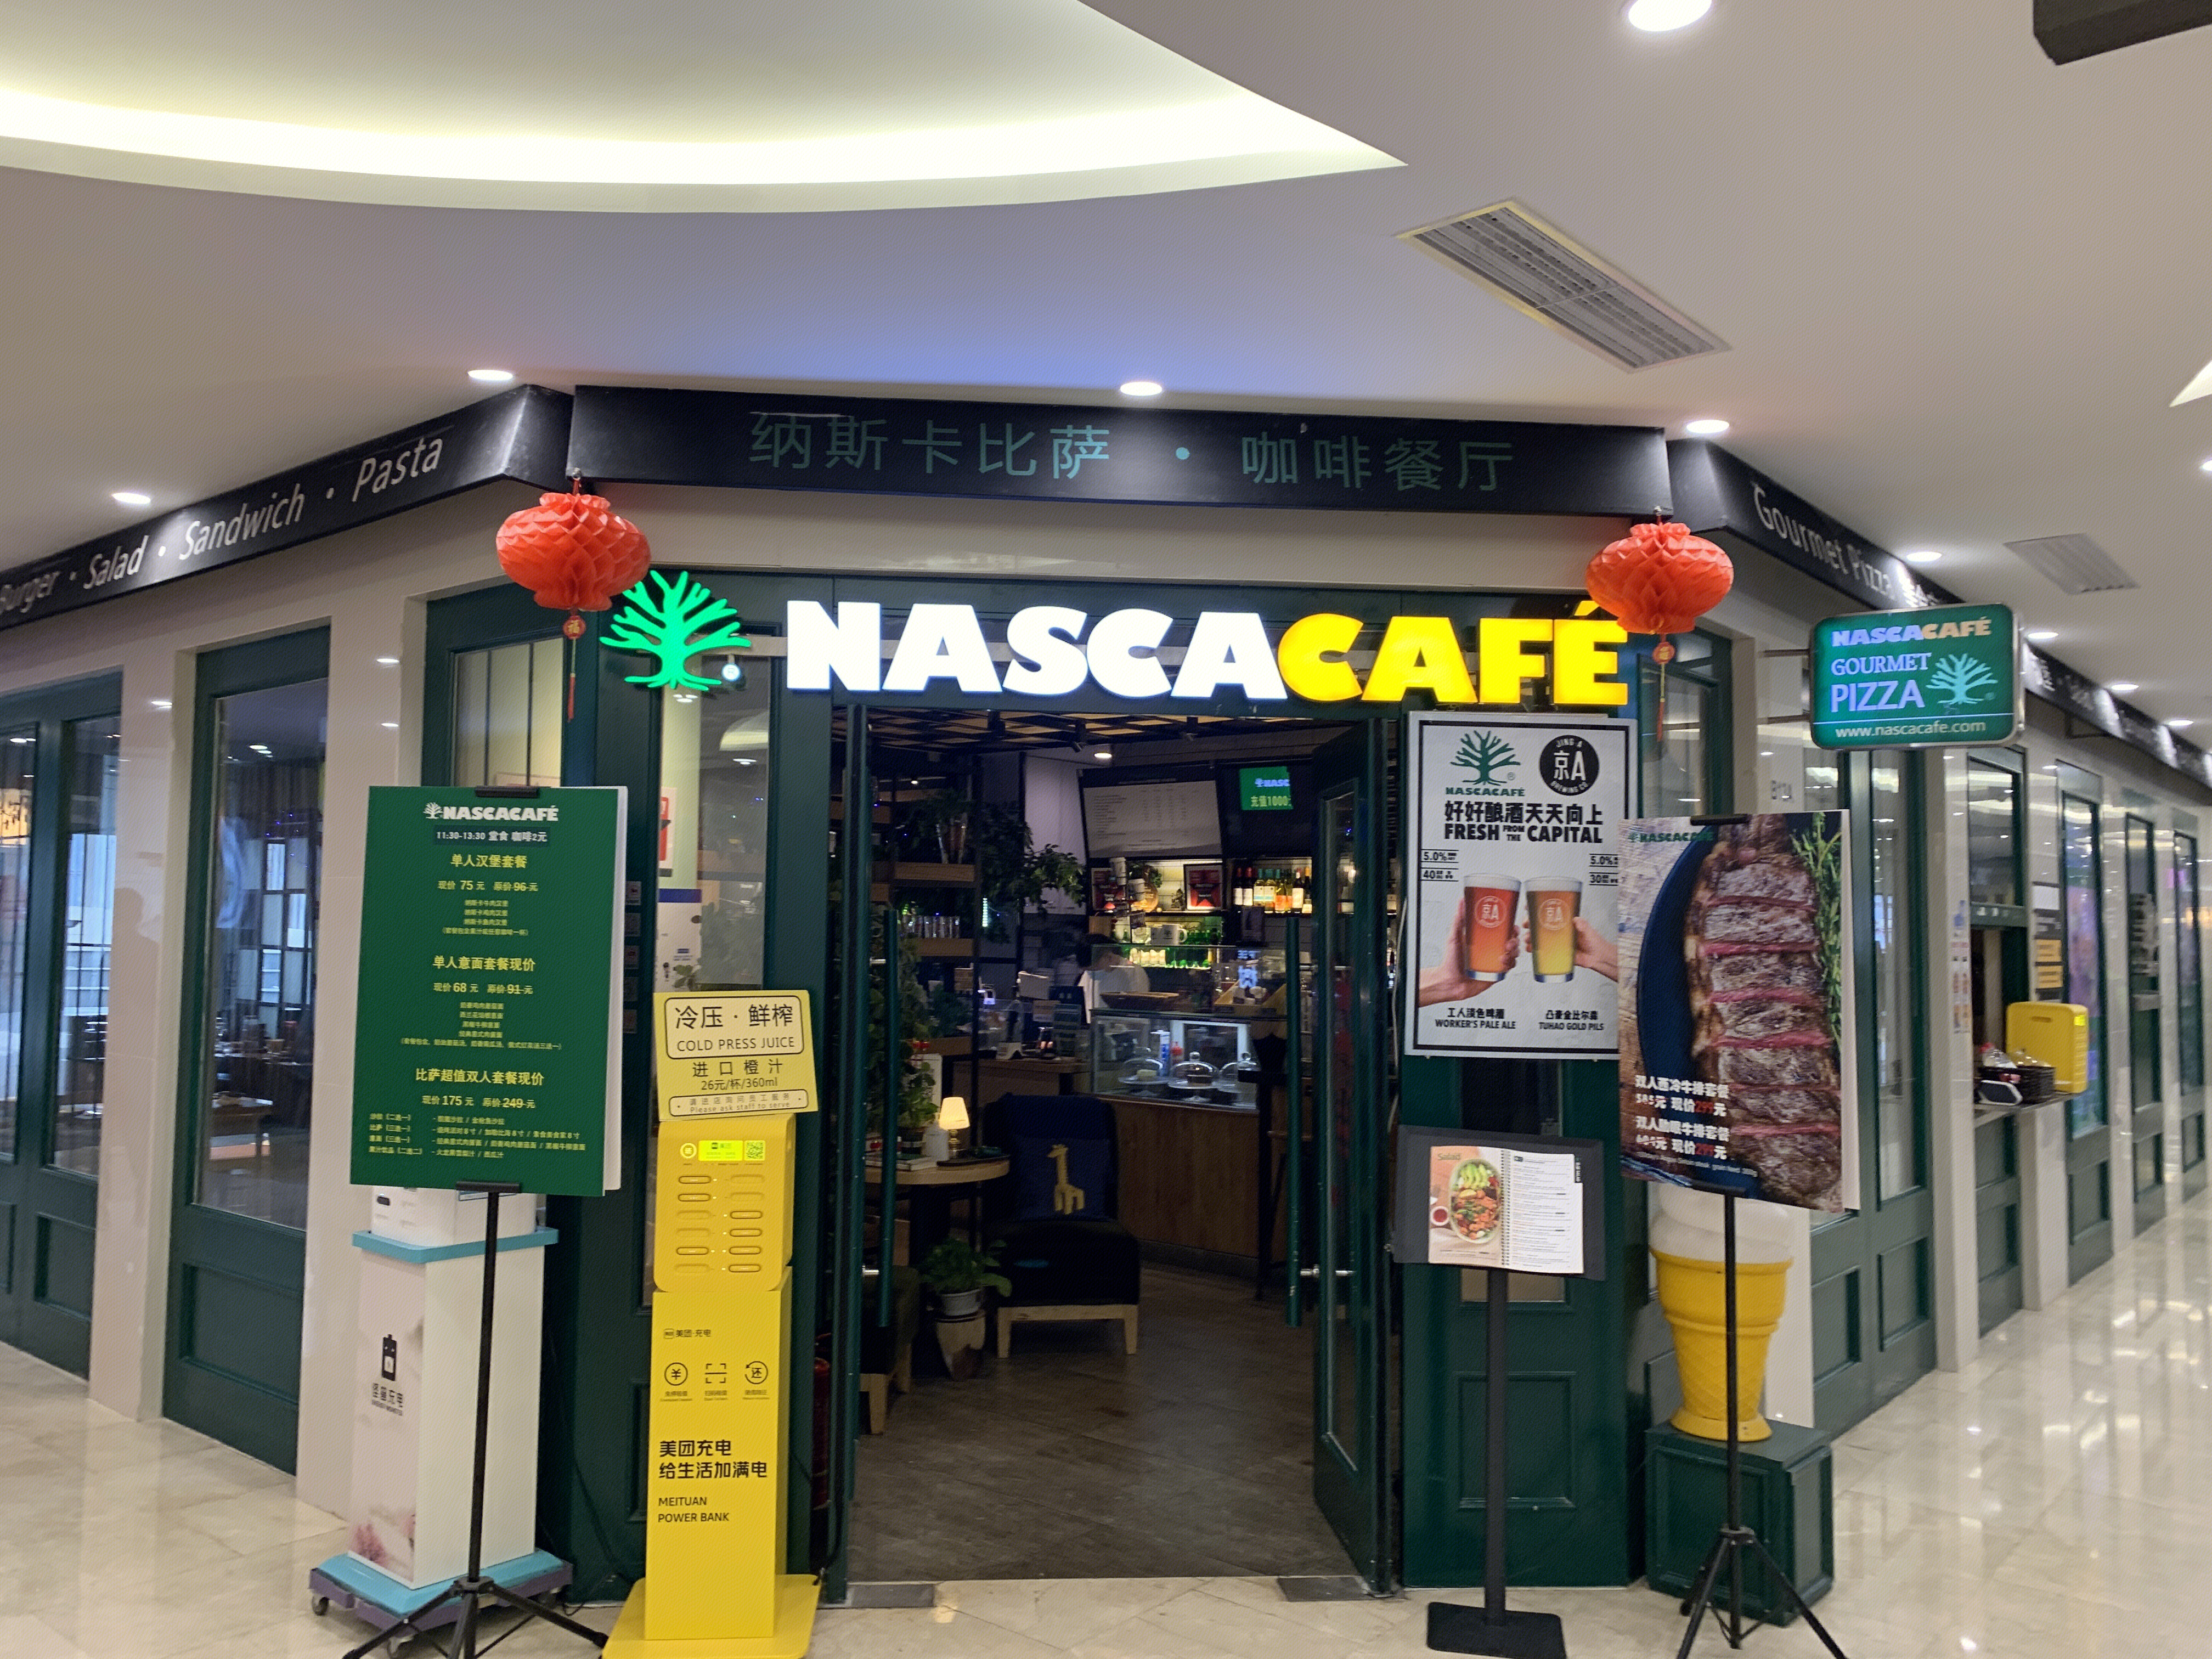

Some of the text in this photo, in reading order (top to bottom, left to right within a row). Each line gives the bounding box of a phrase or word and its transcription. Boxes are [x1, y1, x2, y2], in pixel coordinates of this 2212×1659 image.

[749, 415, 1513, 491] 纳斯卡比萨 咖啡餐厅
[83, 535, 148, 589] Salad
[178, 483, 305, 560] Sandwich
[352, 438, 442, 501] Pasta
[1832, 616, 1991, 647] NASCACAFÉ
[1831, 653, 1932, 676] GOURMET
[1831, 680, 1925, 712] PIZZA
[1836, 720, 1986, 737] www.nascacafe.com
[443, 805, 558, 821] NASCACAFÉ
[1444, 800, 1603, 825] 好好酿酒天天向上
[437, 831, 486, 840] 11:30-13:30
[1444, 823, 1499, 840] FRESH
[1527, 826, 1602, 843] CAPITAL
[450, 854, 527, 868] 单人汉堡套餐
[460, 880, 473, 890] 75
[432, 955, 536, 971] 单人意面套餐现价
[453, 983, 467, 992] 68
[1435, 1019, 1516, 1029] WORKER'S PALE ALE
[677, 1037, 794, 1052] COLD PRESS JUICE
[692, 1059, 783, 1077] 进口橙汁
[415, 1068, 544, 1086] 比萨超值双人套餐现价
[701, 1077, 777, 1090] 26元/杯/360ml
[442, 1096, 462, 1106] 175
[659, 1440, 731, 1457] 美团充电
[659, 1462, 768, 1479] 给生活加满电
[658, 1497, 707, 1506] MEITUAN
[658, 1513, 729, 1522] POWER BANK
